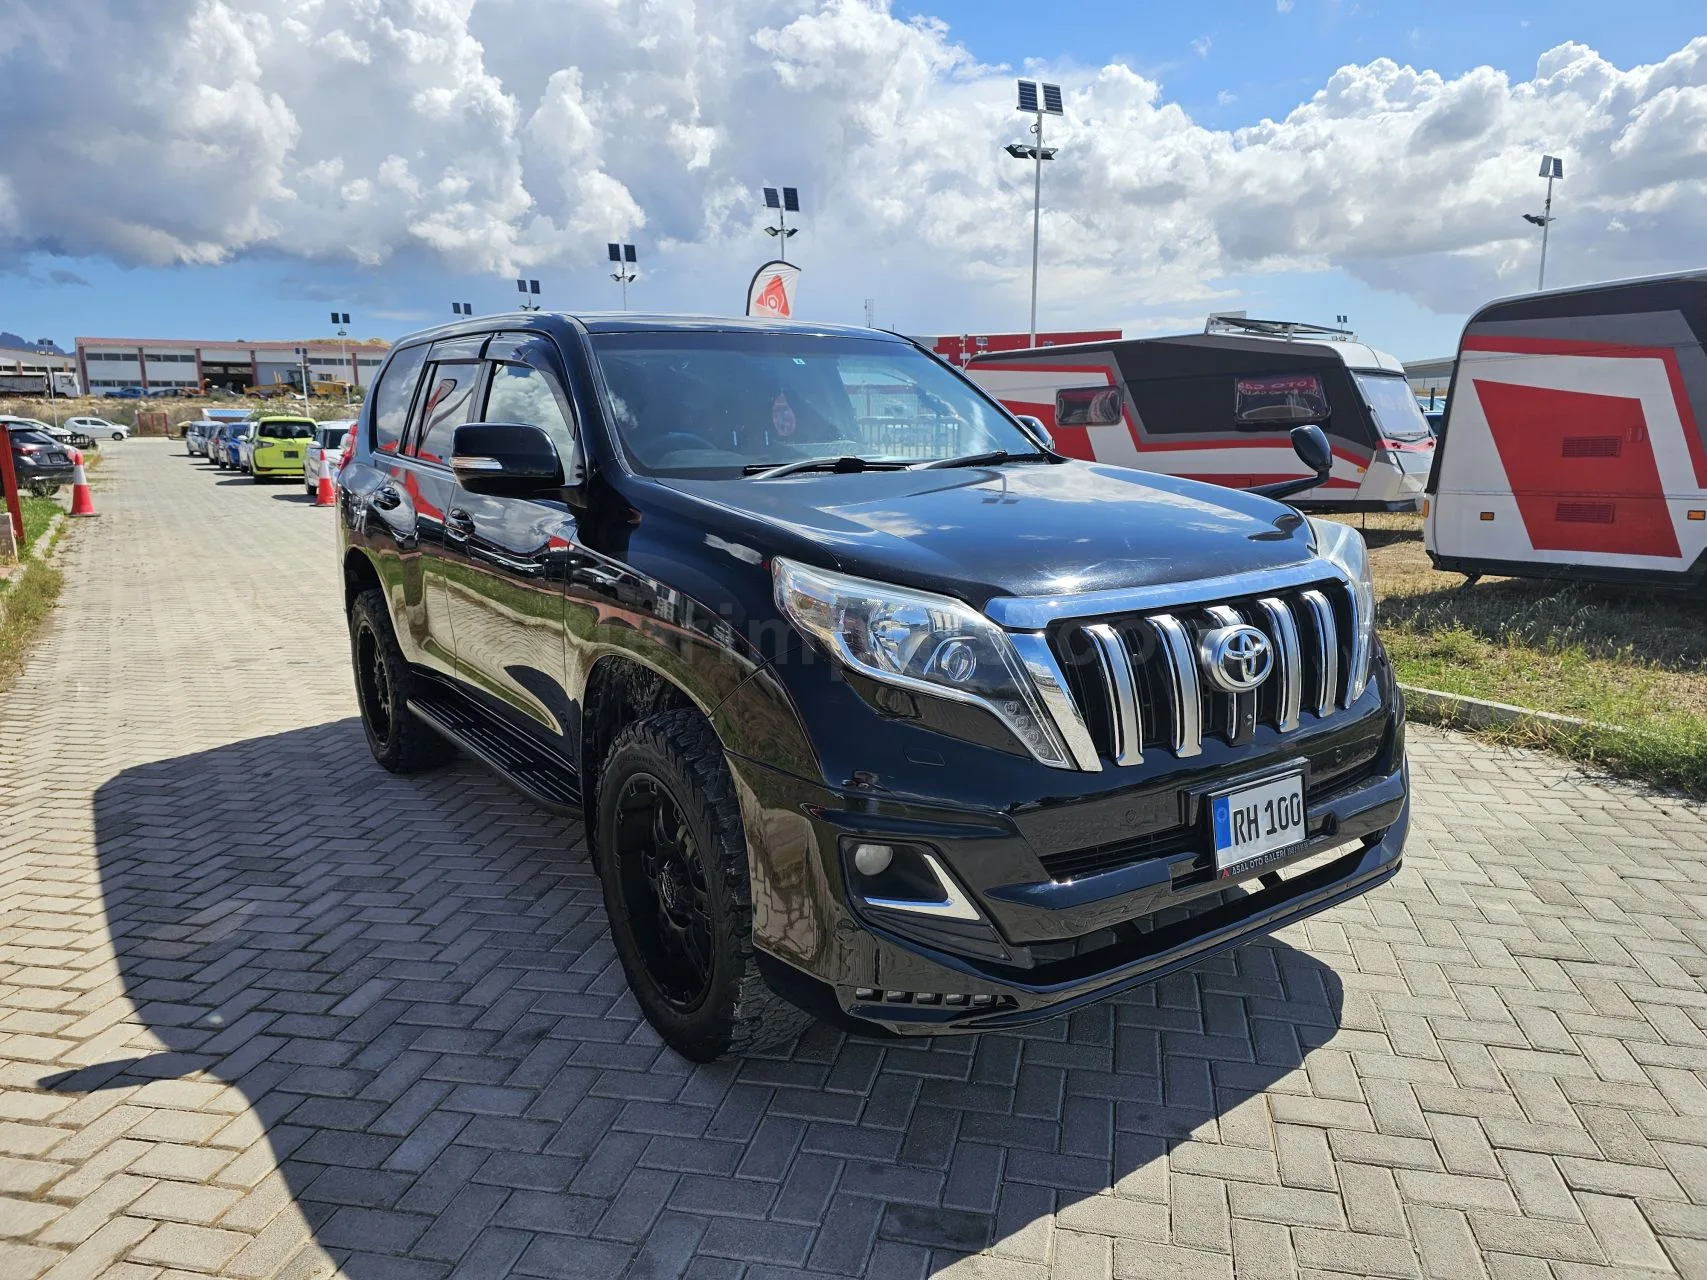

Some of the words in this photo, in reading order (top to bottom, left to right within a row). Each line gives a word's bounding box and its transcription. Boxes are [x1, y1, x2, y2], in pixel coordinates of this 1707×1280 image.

[1232, 804, 1260, 845] RH
[1264, 792, 1302, 835] 100
[1232, 865, 1249, 875] ASAL
[1249, 859, 1263, 868] OTO
